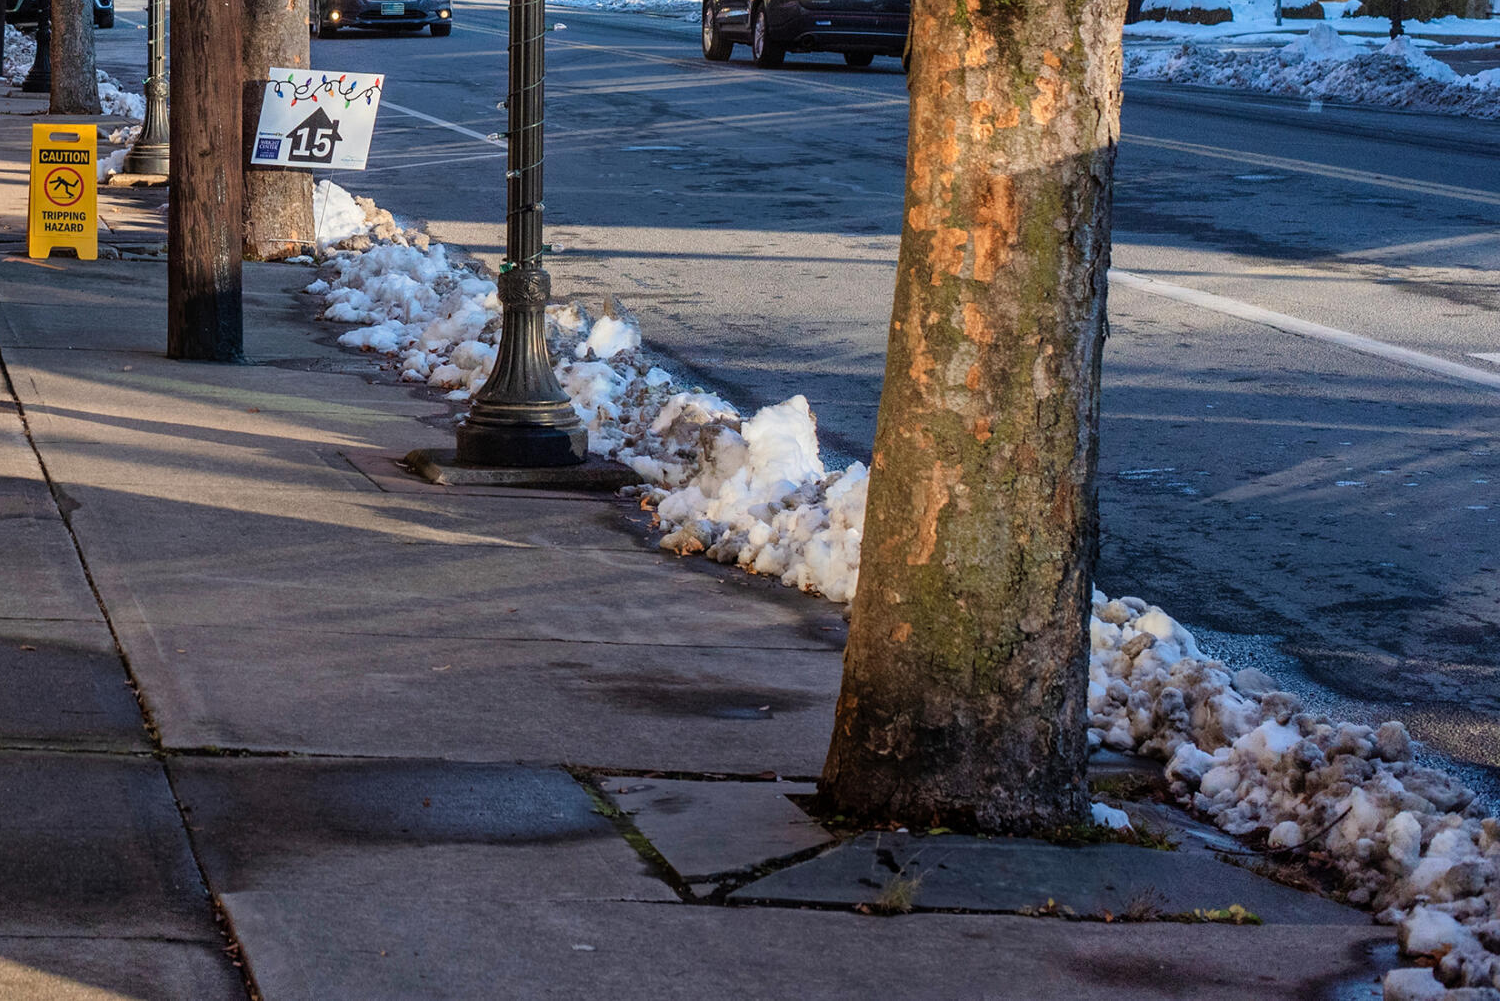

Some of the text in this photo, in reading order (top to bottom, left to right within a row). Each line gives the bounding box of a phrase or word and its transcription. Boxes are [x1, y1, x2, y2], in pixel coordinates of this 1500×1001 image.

[293, 127, 332, 157] 15
[41, 151, 88, 163] CAUTION
[42, 210, 86, 221] TRIPPING
[44, 222, 84, 232] HAZARD
